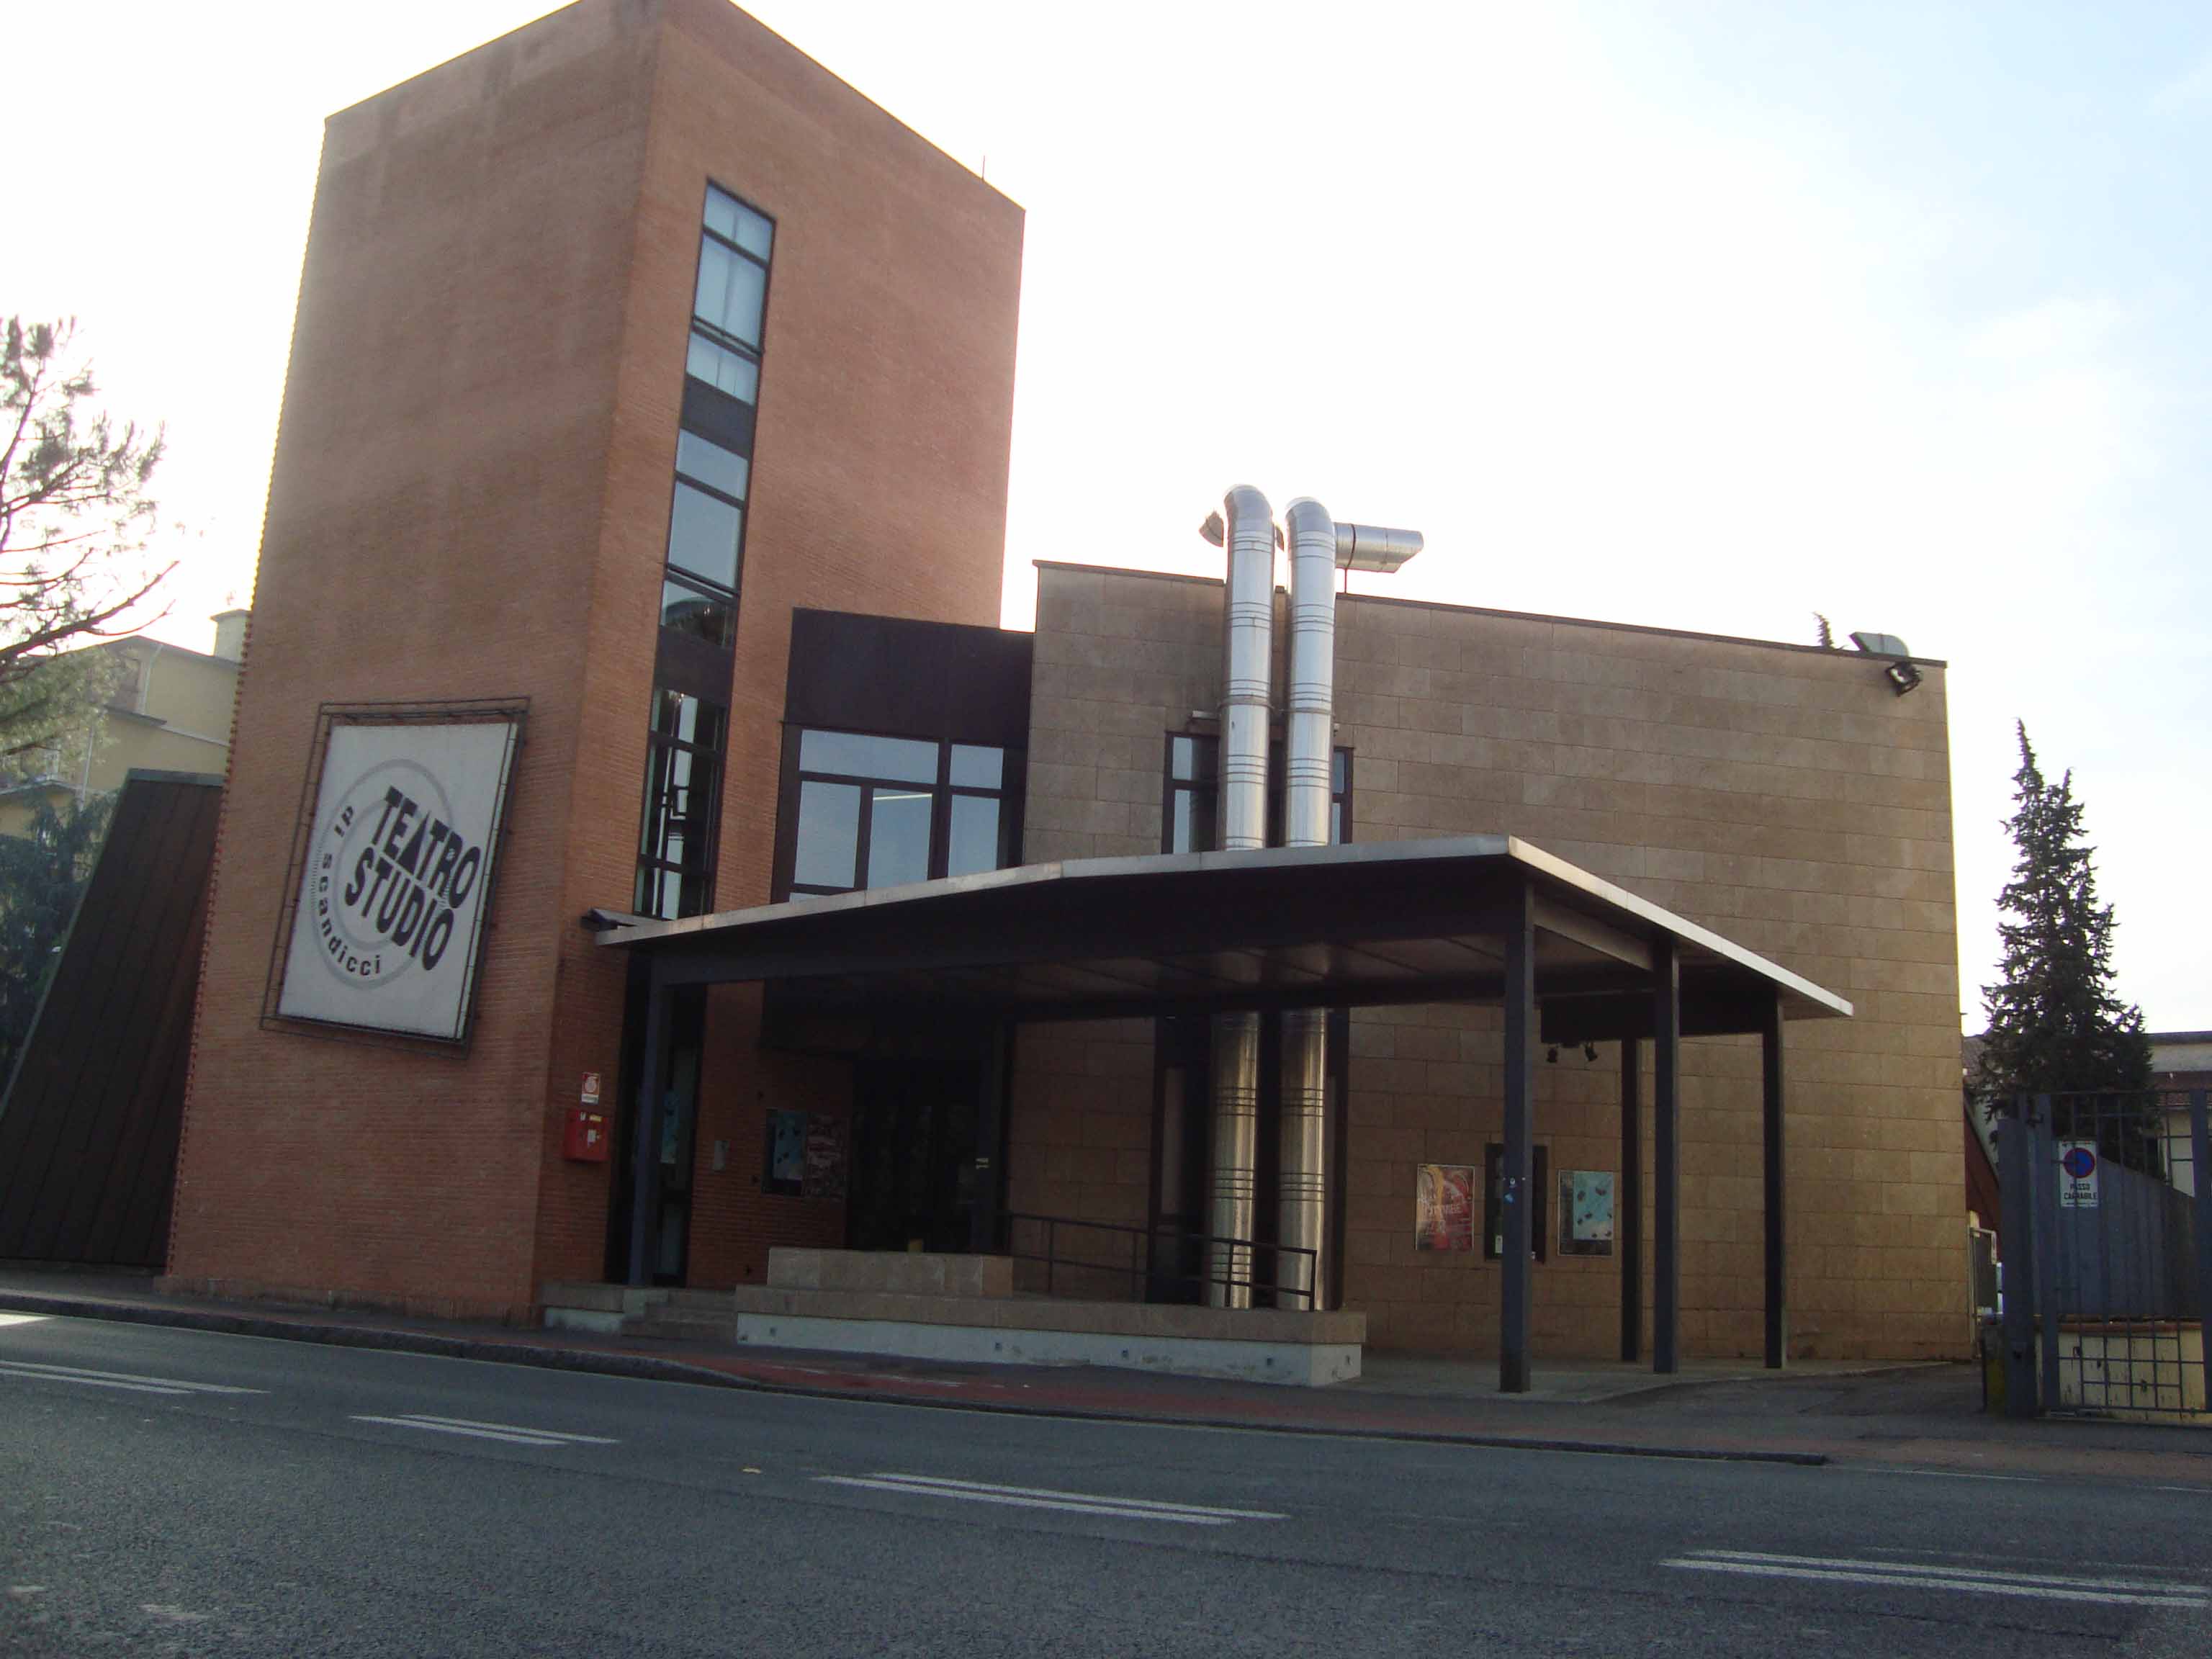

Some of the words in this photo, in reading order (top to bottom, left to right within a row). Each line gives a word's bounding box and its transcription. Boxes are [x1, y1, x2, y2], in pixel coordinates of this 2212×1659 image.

[344, 847, 454, 971] STUDIO
[371, 786, 481, 909] TEATRO
[318, 853, 381, 976] scandicci
